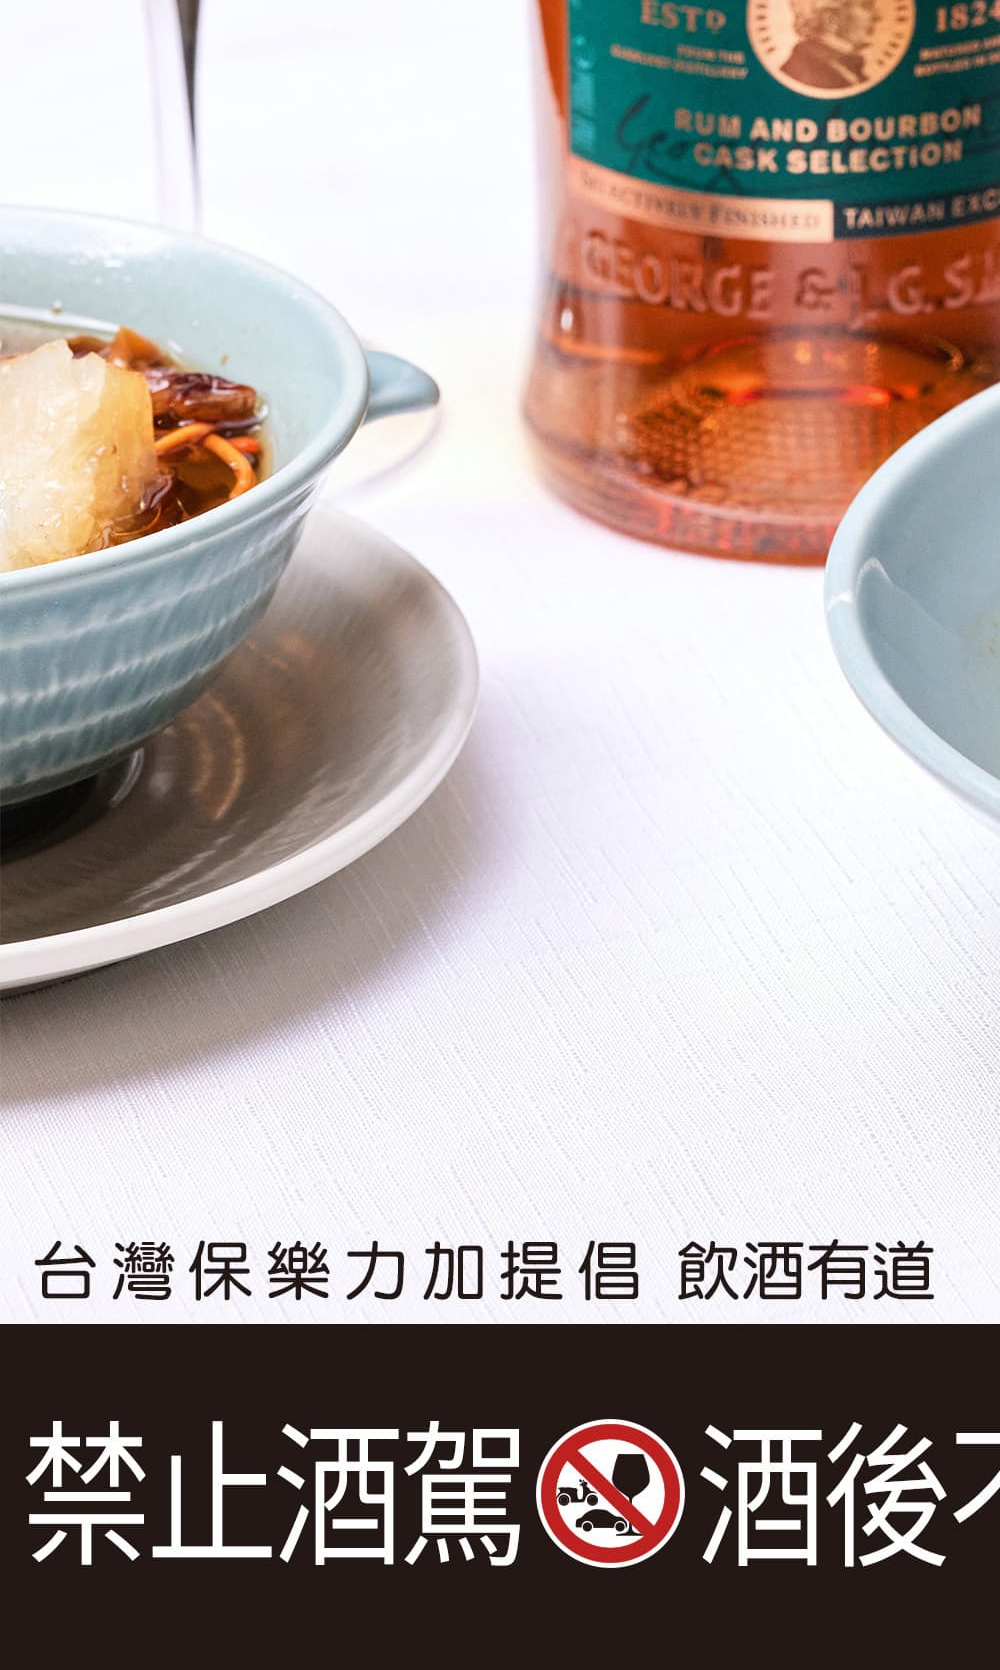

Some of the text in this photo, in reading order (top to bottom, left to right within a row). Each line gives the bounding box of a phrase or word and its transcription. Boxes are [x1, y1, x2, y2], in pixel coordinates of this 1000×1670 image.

[674, 103, 981, 144] RUM AND BOURBON
[694, 138, 962, 174] CASK SELECTION
[843, 200, 946, 230] TAIWAN
[581, 232, 776, 320] GEORGE
